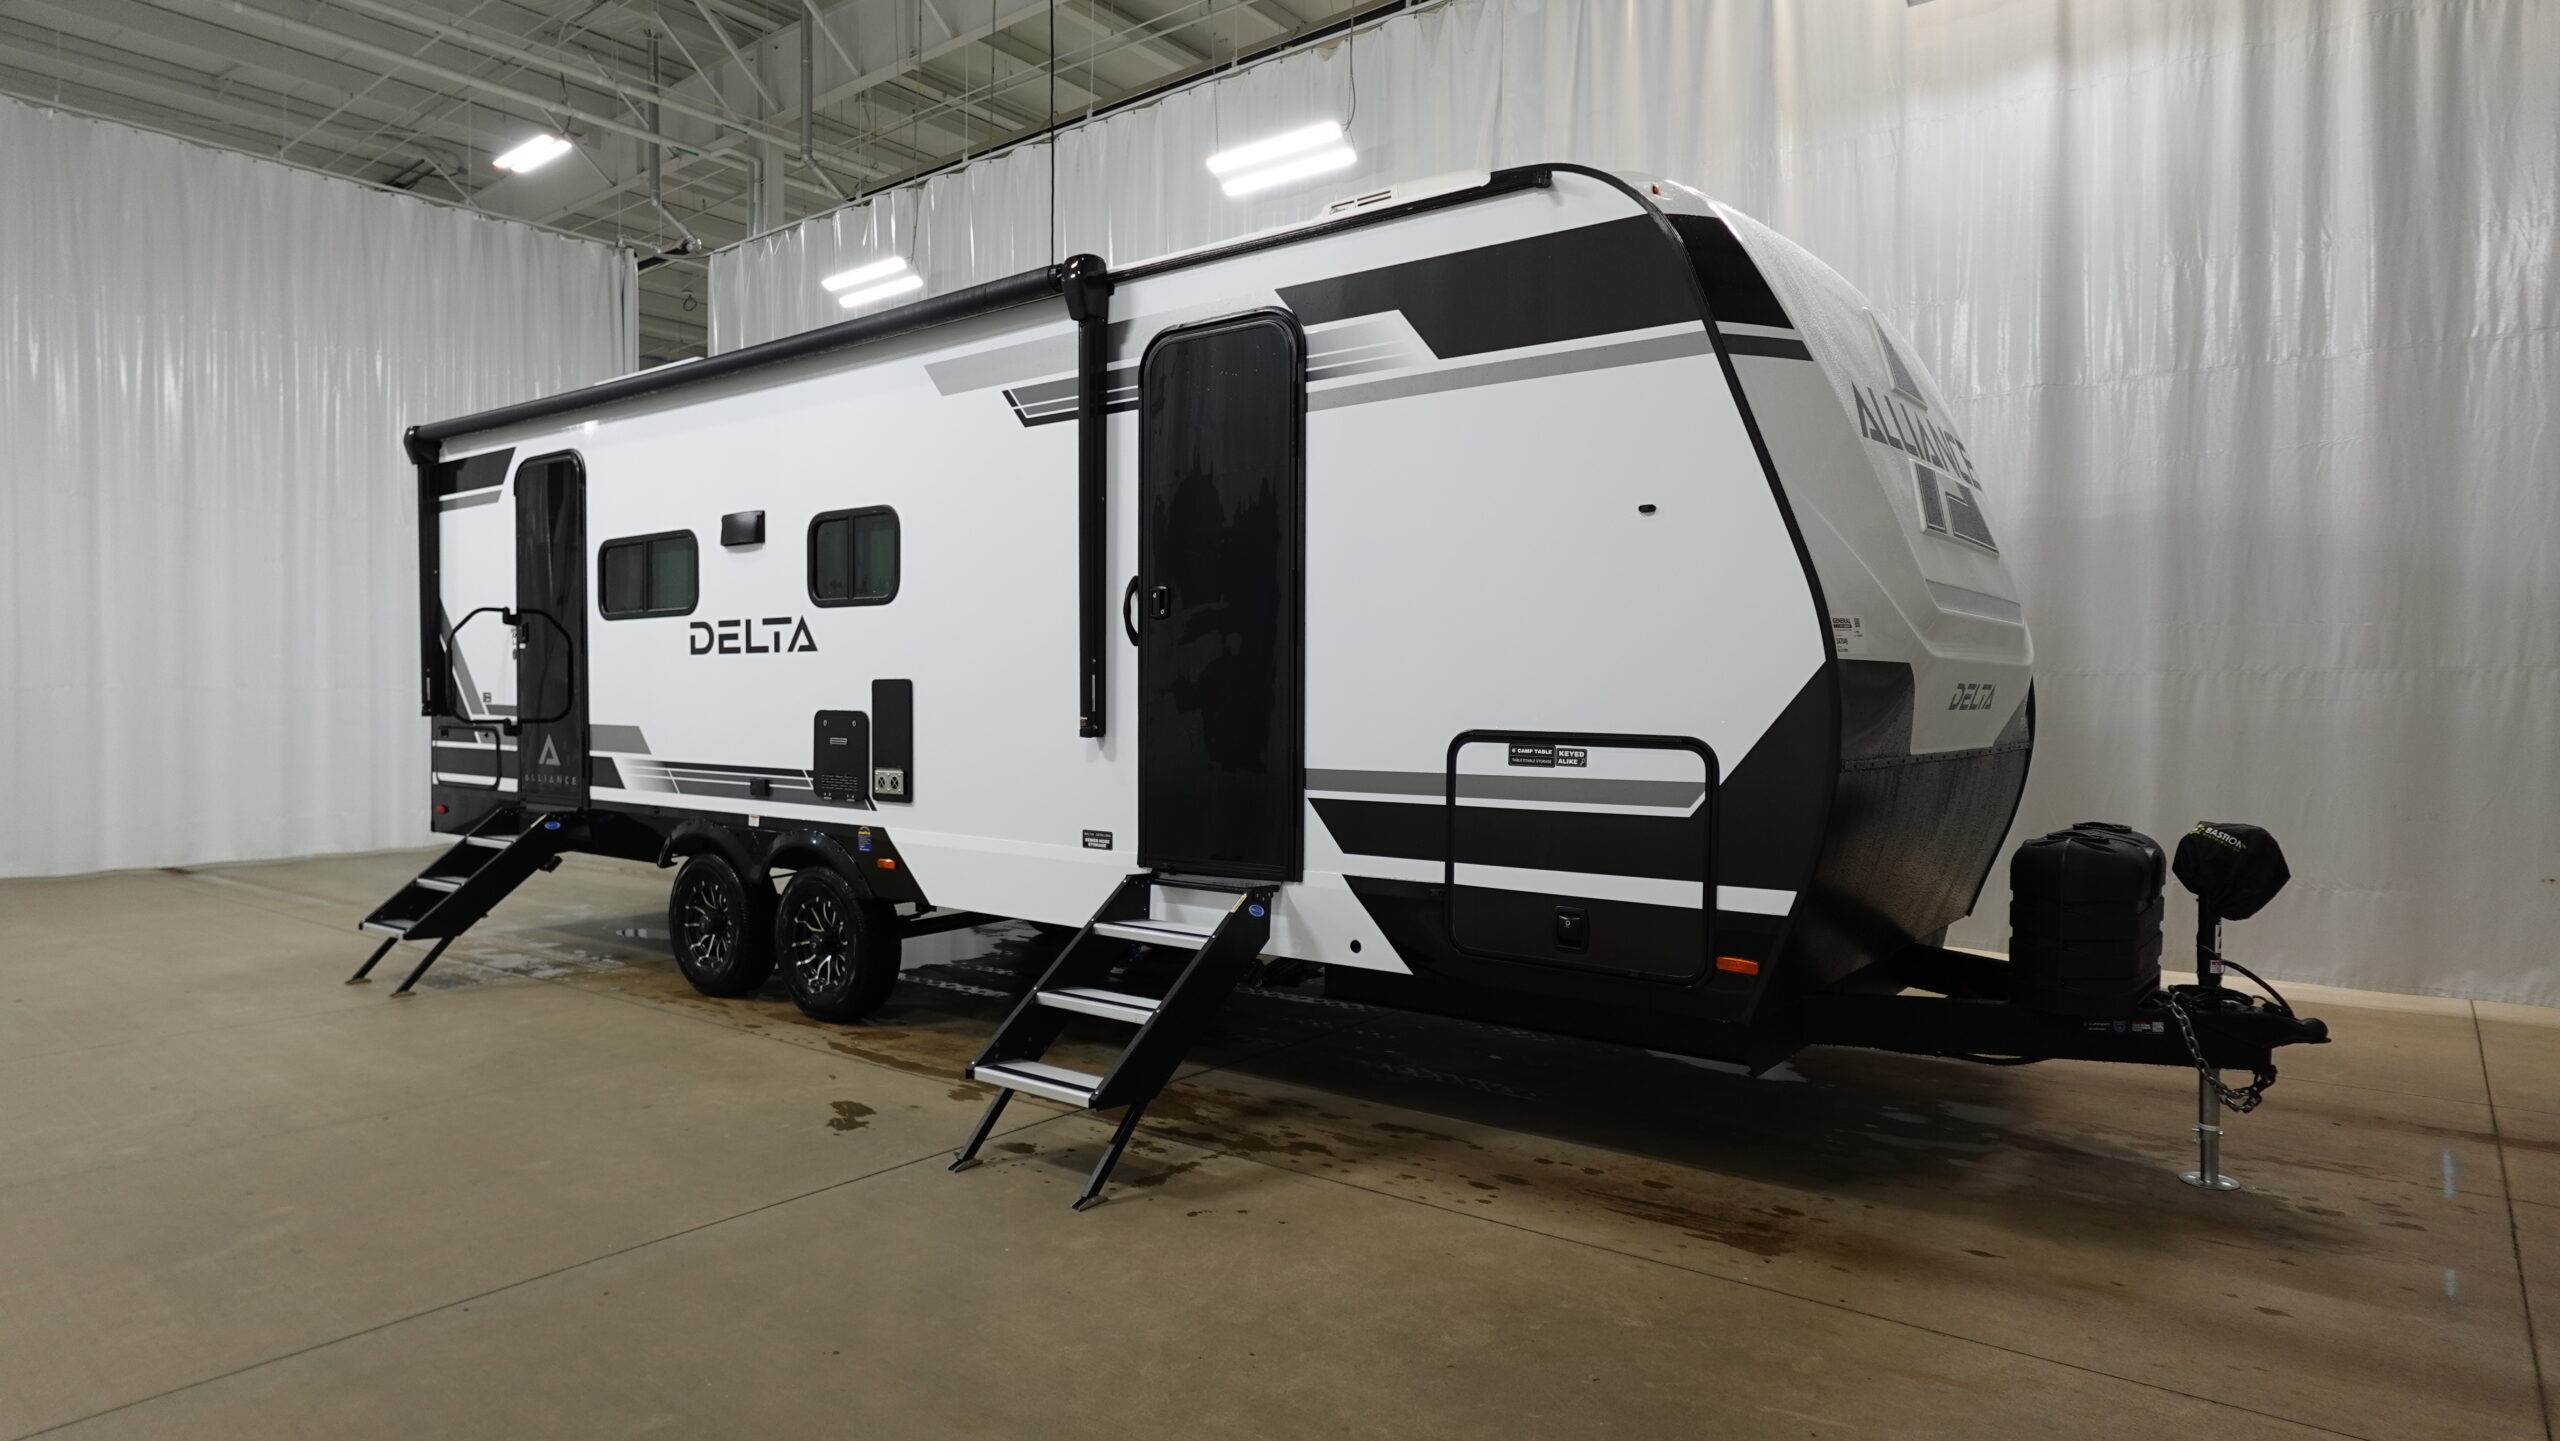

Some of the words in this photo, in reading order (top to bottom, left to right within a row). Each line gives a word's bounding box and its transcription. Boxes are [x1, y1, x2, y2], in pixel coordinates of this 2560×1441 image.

[1851, 379, 1984, 492] ALLIANCE
[690, 615, 818, 655] DELTA
[1948, 683, 1996, 710] DELTA
[524, 773, 577, 785] ALLIANCE
[2205, 826, 2242, 849] BASTION
